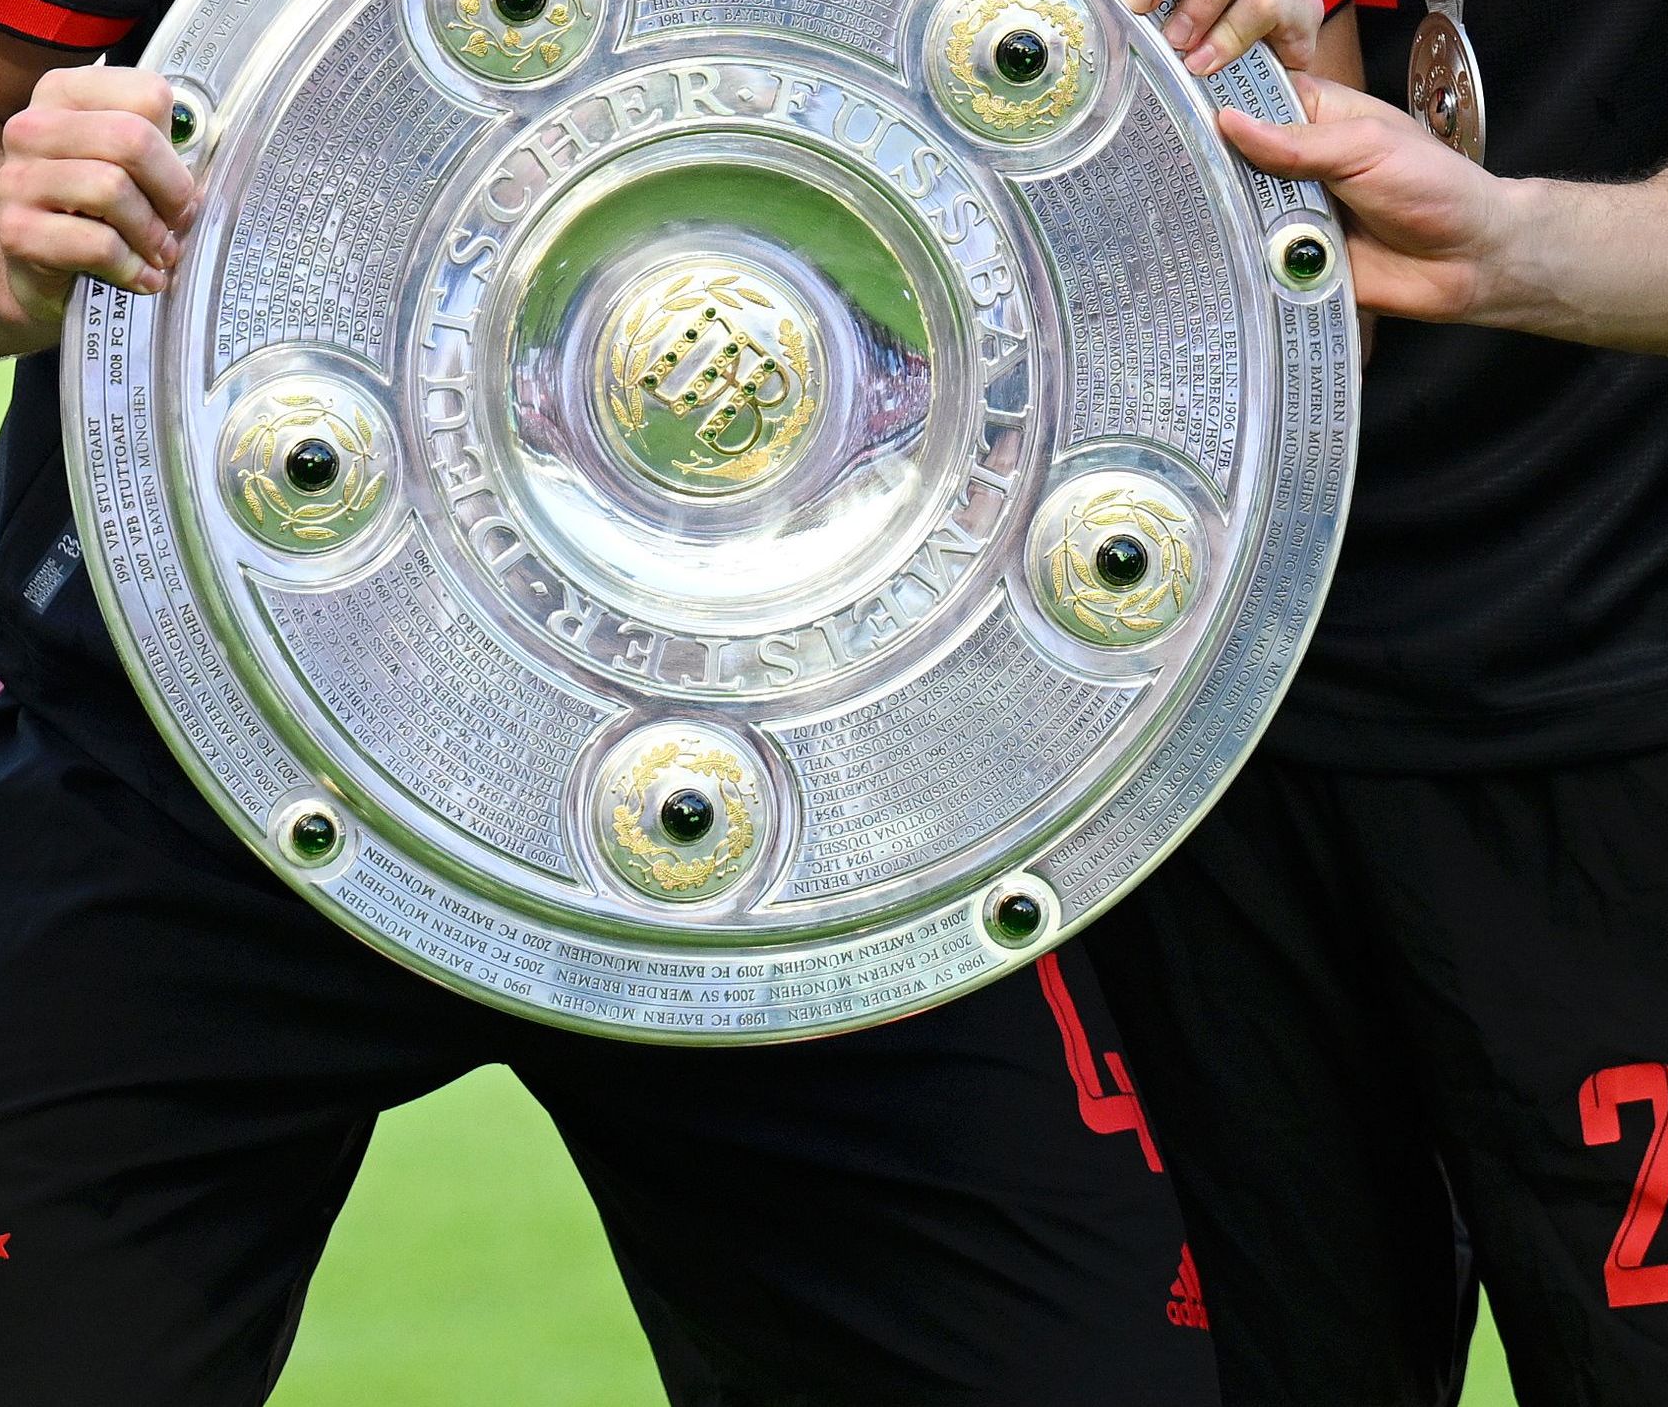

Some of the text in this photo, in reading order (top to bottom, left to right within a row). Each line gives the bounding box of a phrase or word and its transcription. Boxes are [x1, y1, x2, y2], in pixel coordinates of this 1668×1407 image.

[1245, 48, 1271, 81] VFB
[421, 64, 734, 589] DEUTSCHER
[1102, 235, 1138, 377] WERDER BREMEN
[1213, 266, 1237, 388] UNION BERLIN
[87, 416, 131, 585] 1992 VFB STUTTGART
[111, 412, 156, 582] 2007 VFB STUTTGART
[1230, 298, 1346, 741] 1985 FC BAYERN MÜNCHEN 1986 FC BAYERN MÜNCHEN
[130, 385, 300, 785] 2021 FC BAYERN MÜNCHEN 2022 FC BAYERN MÜNCHEN
[139, 632, 264, 816] 1991 1.FC KAISERSLAUTERN
[152, 606, 280, 798] 2006 FC BAYERN MÜNCHEN
[812, 768, 890, 809] HAMBURG
[889, 806, 967, 855] HAMBURG
[351, 867, 972, 1003] 2003 FC BAYERN MÜNCHEN 2004 SV WERDER BREMEN 2005 FC BAYERN MÜNCHEN
[360, 844, 968, 978] 2018 FC BAYERN MÜNCHEN 2019 FC BAYERN MÜNCHEN 2020 FC BAYERN MÜNCHEN
[792, 844, 928, 897] VIKTORIA BERLIN
[333, 883, 986, 1026] 1988 SV WERDER BREMEN 1989 FC BAYERN MÜNCHEN 1990 FC BAYERN MÜNCHEN
